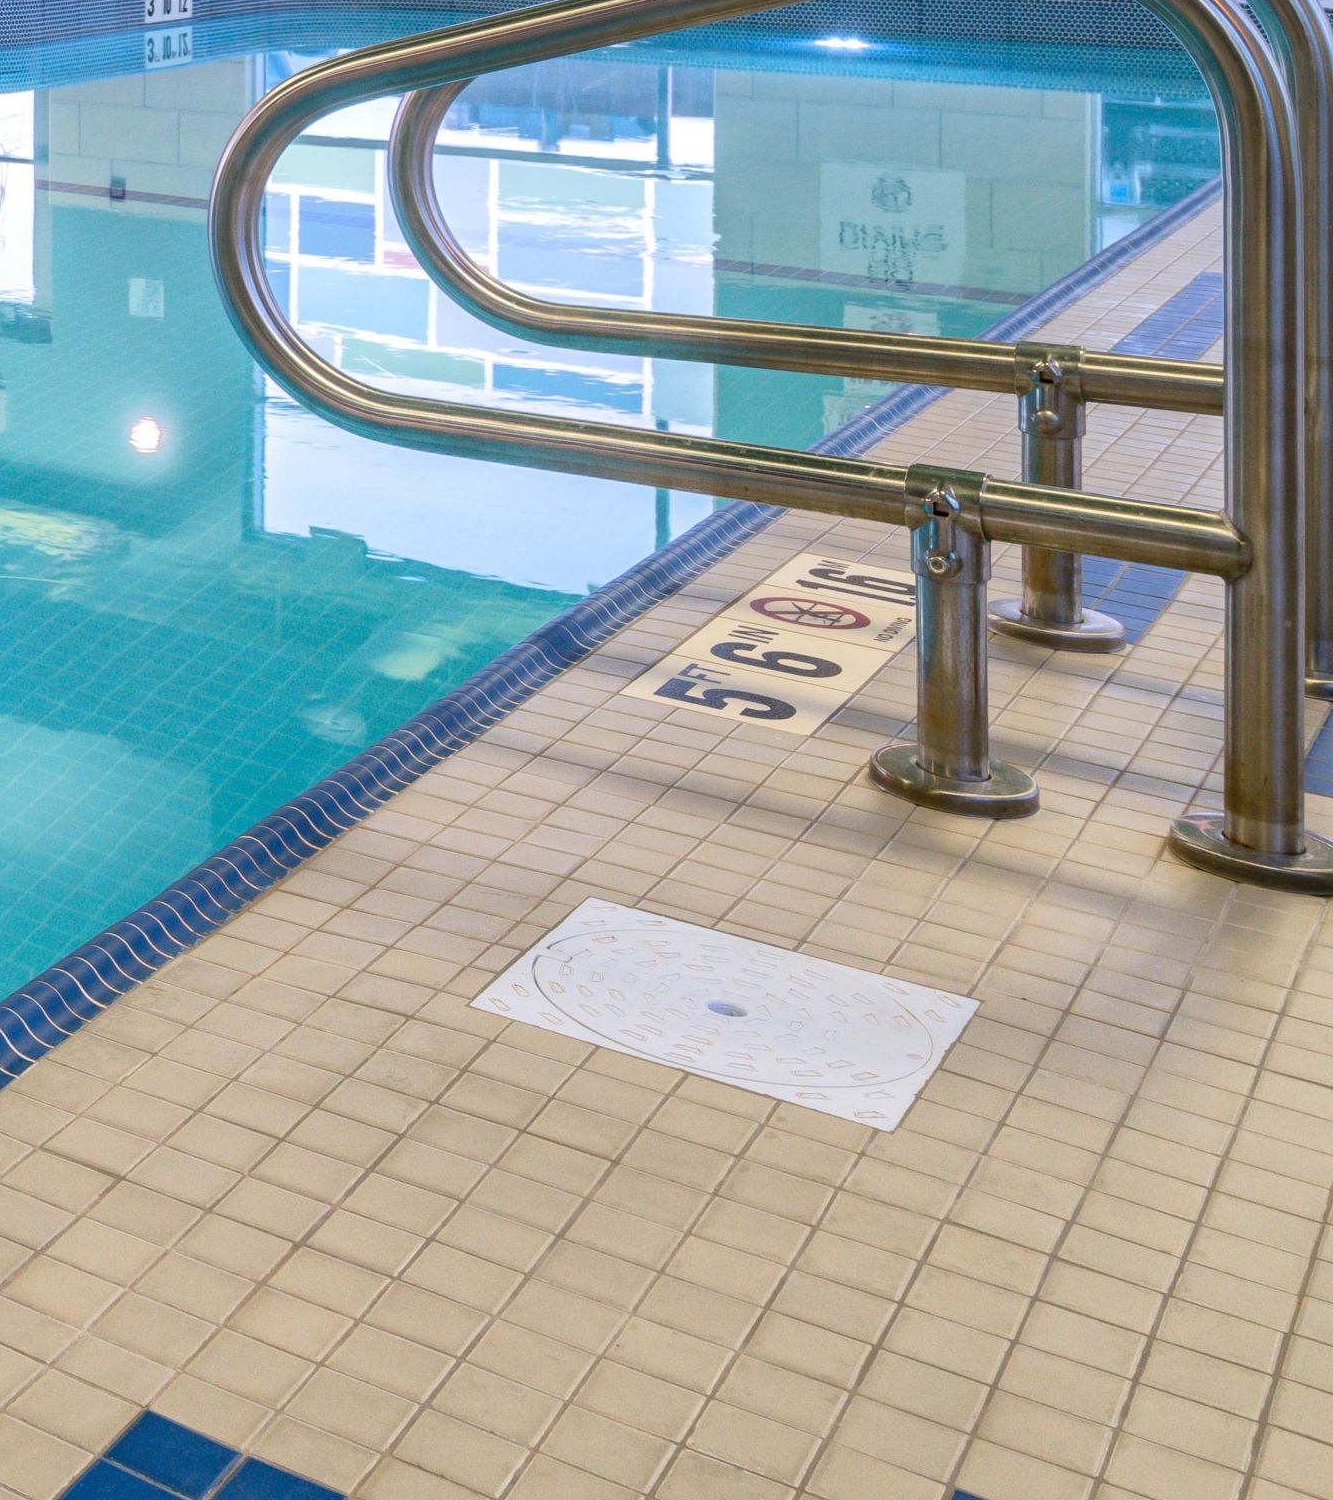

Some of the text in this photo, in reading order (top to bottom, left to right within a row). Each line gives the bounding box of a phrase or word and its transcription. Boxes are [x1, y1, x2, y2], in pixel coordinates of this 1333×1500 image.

[873, 617, 912, 643] NO DIVING
[710, 642, 842, 678] 6
[653, 678, 797, 720] 5
